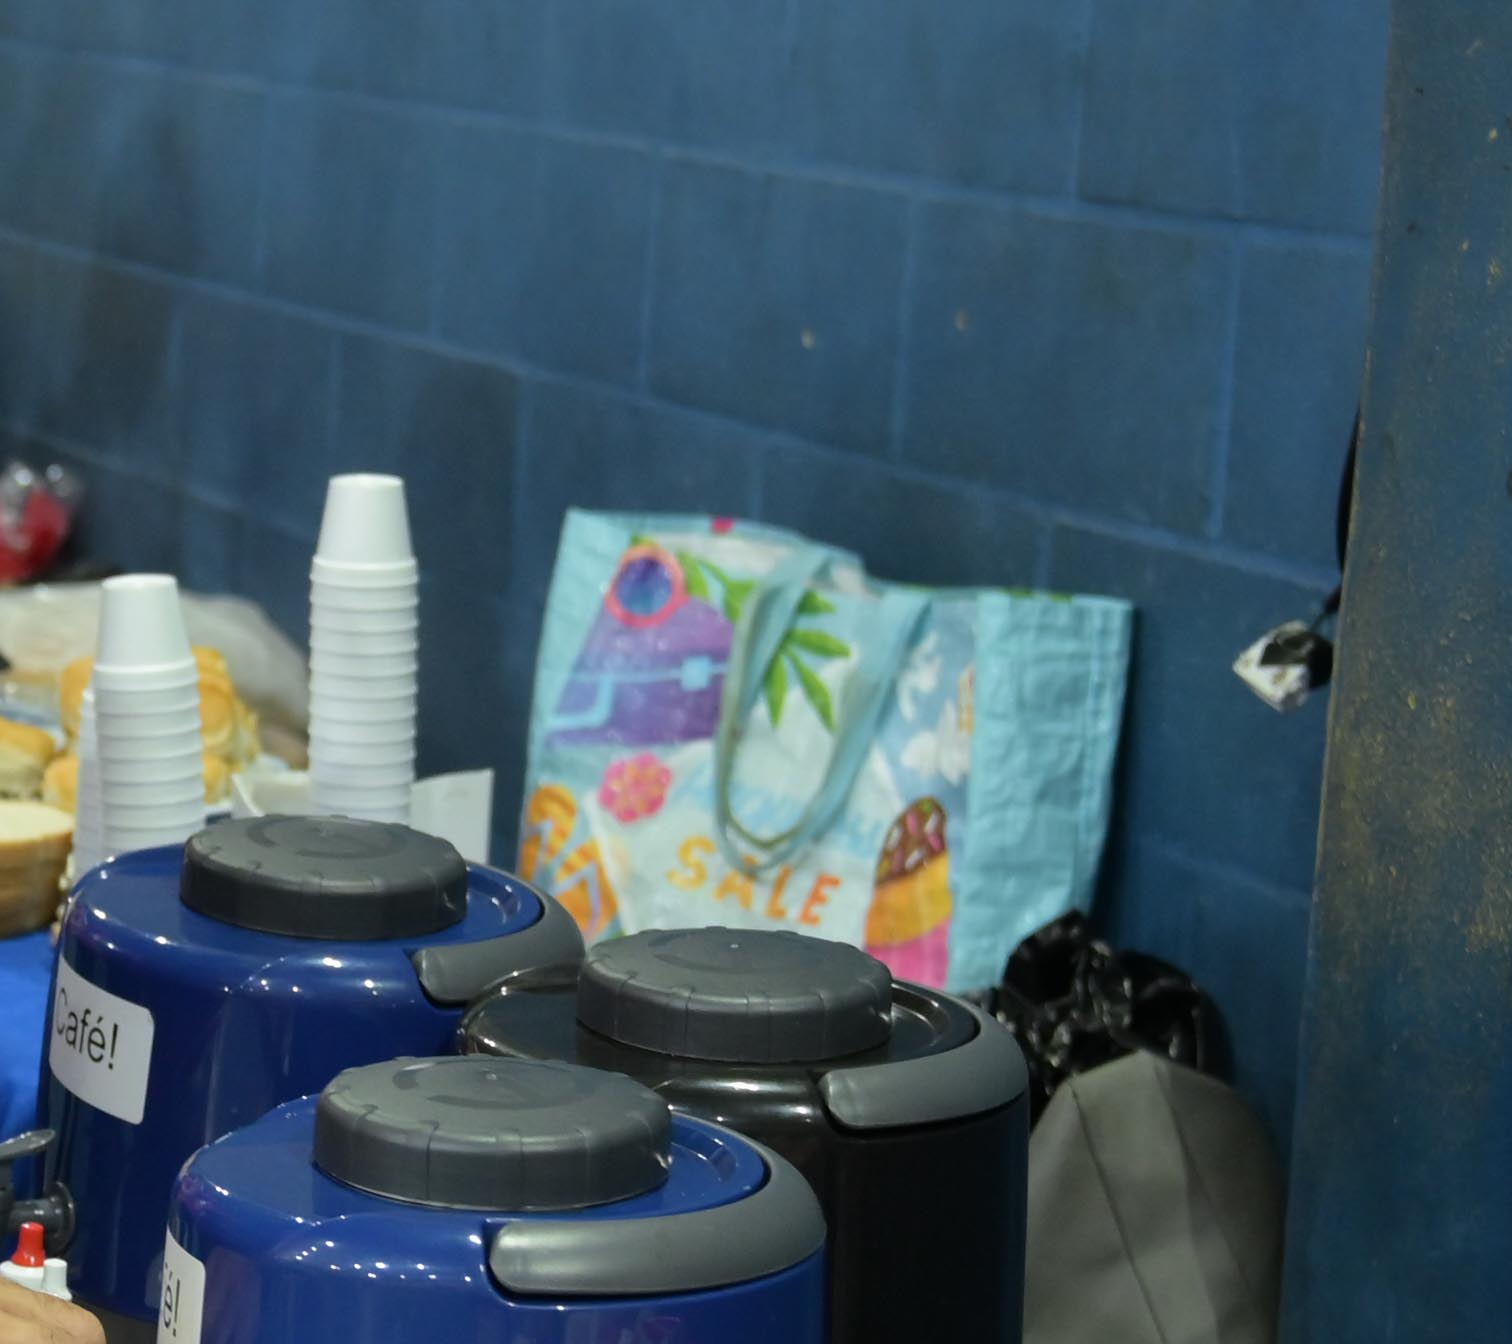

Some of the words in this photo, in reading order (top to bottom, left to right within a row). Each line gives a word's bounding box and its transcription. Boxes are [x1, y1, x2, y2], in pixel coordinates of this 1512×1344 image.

[665, 837, 841, 927] SALE
[55, 987, 119, 1070] Café!
[163, 1262, 181, 1337] é!
